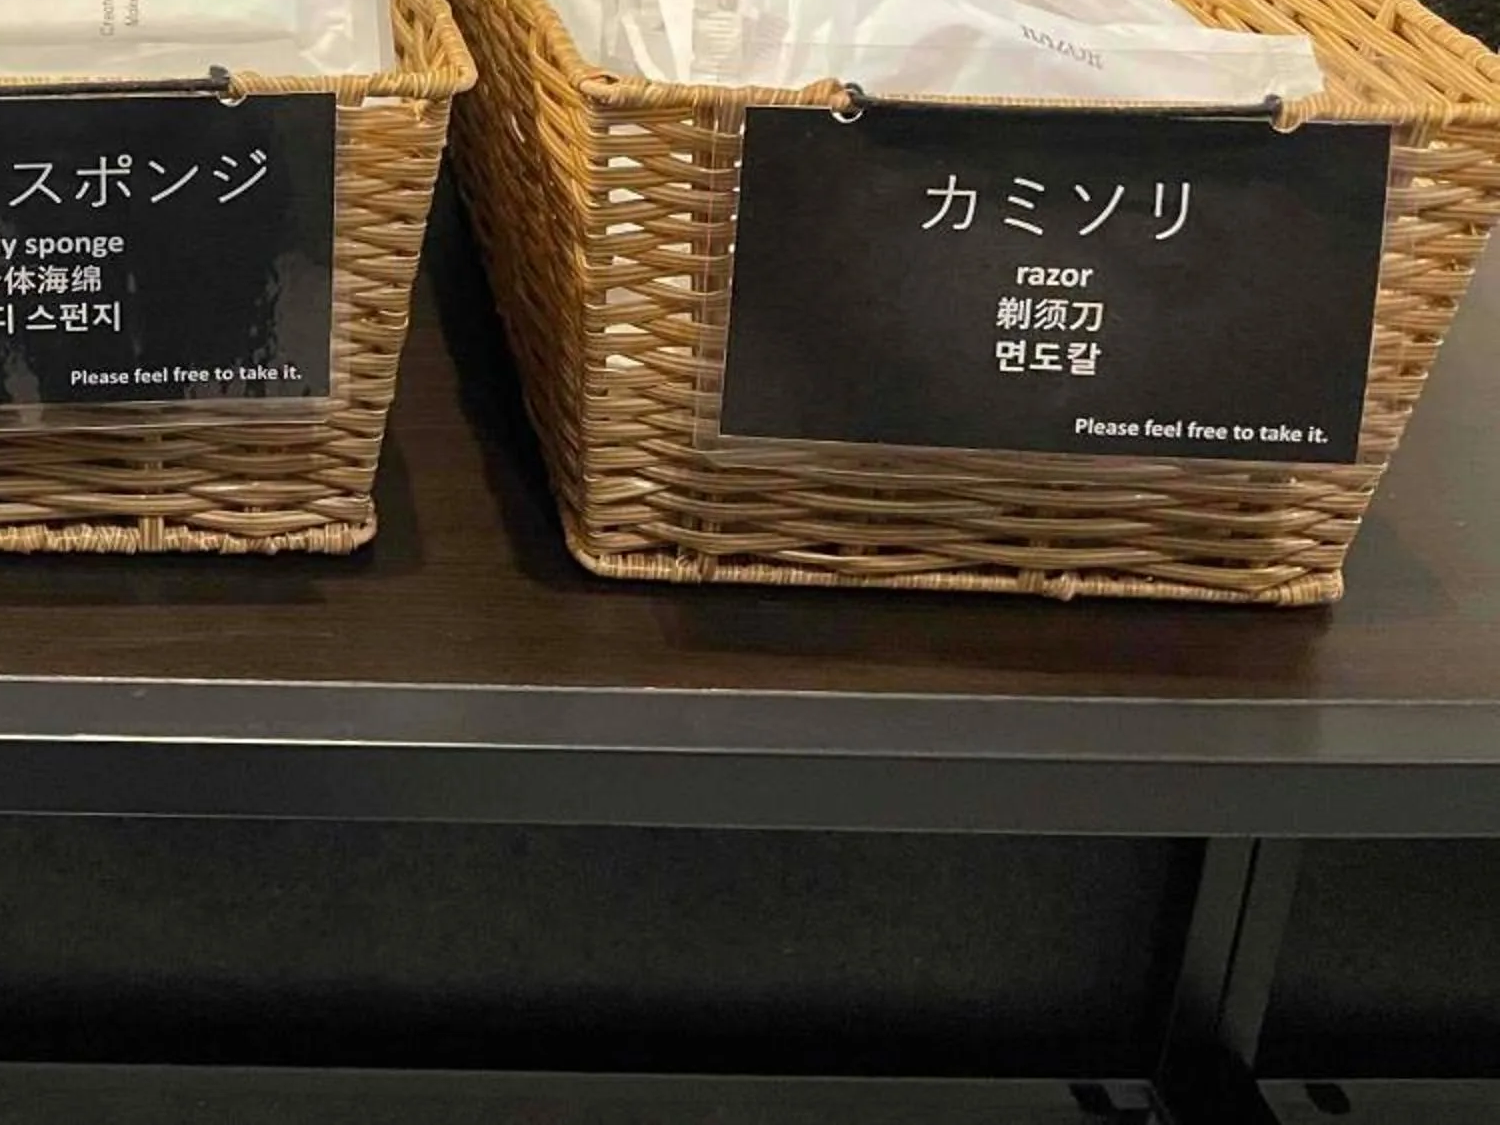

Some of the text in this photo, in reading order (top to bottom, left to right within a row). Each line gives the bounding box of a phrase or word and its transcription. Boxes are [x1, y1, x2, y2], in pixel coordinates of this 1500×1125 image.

[921, 174, 1191, 240] カミソリ
[25, 236, 124, 260] sponge
[1016, 266, 1094, 288] razor
[25, 301, 120, 332] 스펀지
[995, 296, 1104, 332] 剃须刀
[995, 339, 1102, 376] 면도칼
[71, 364, 302, 386] Please feel free to take it.
[1075, 417, 1329, 444] Please feel free to take it.
